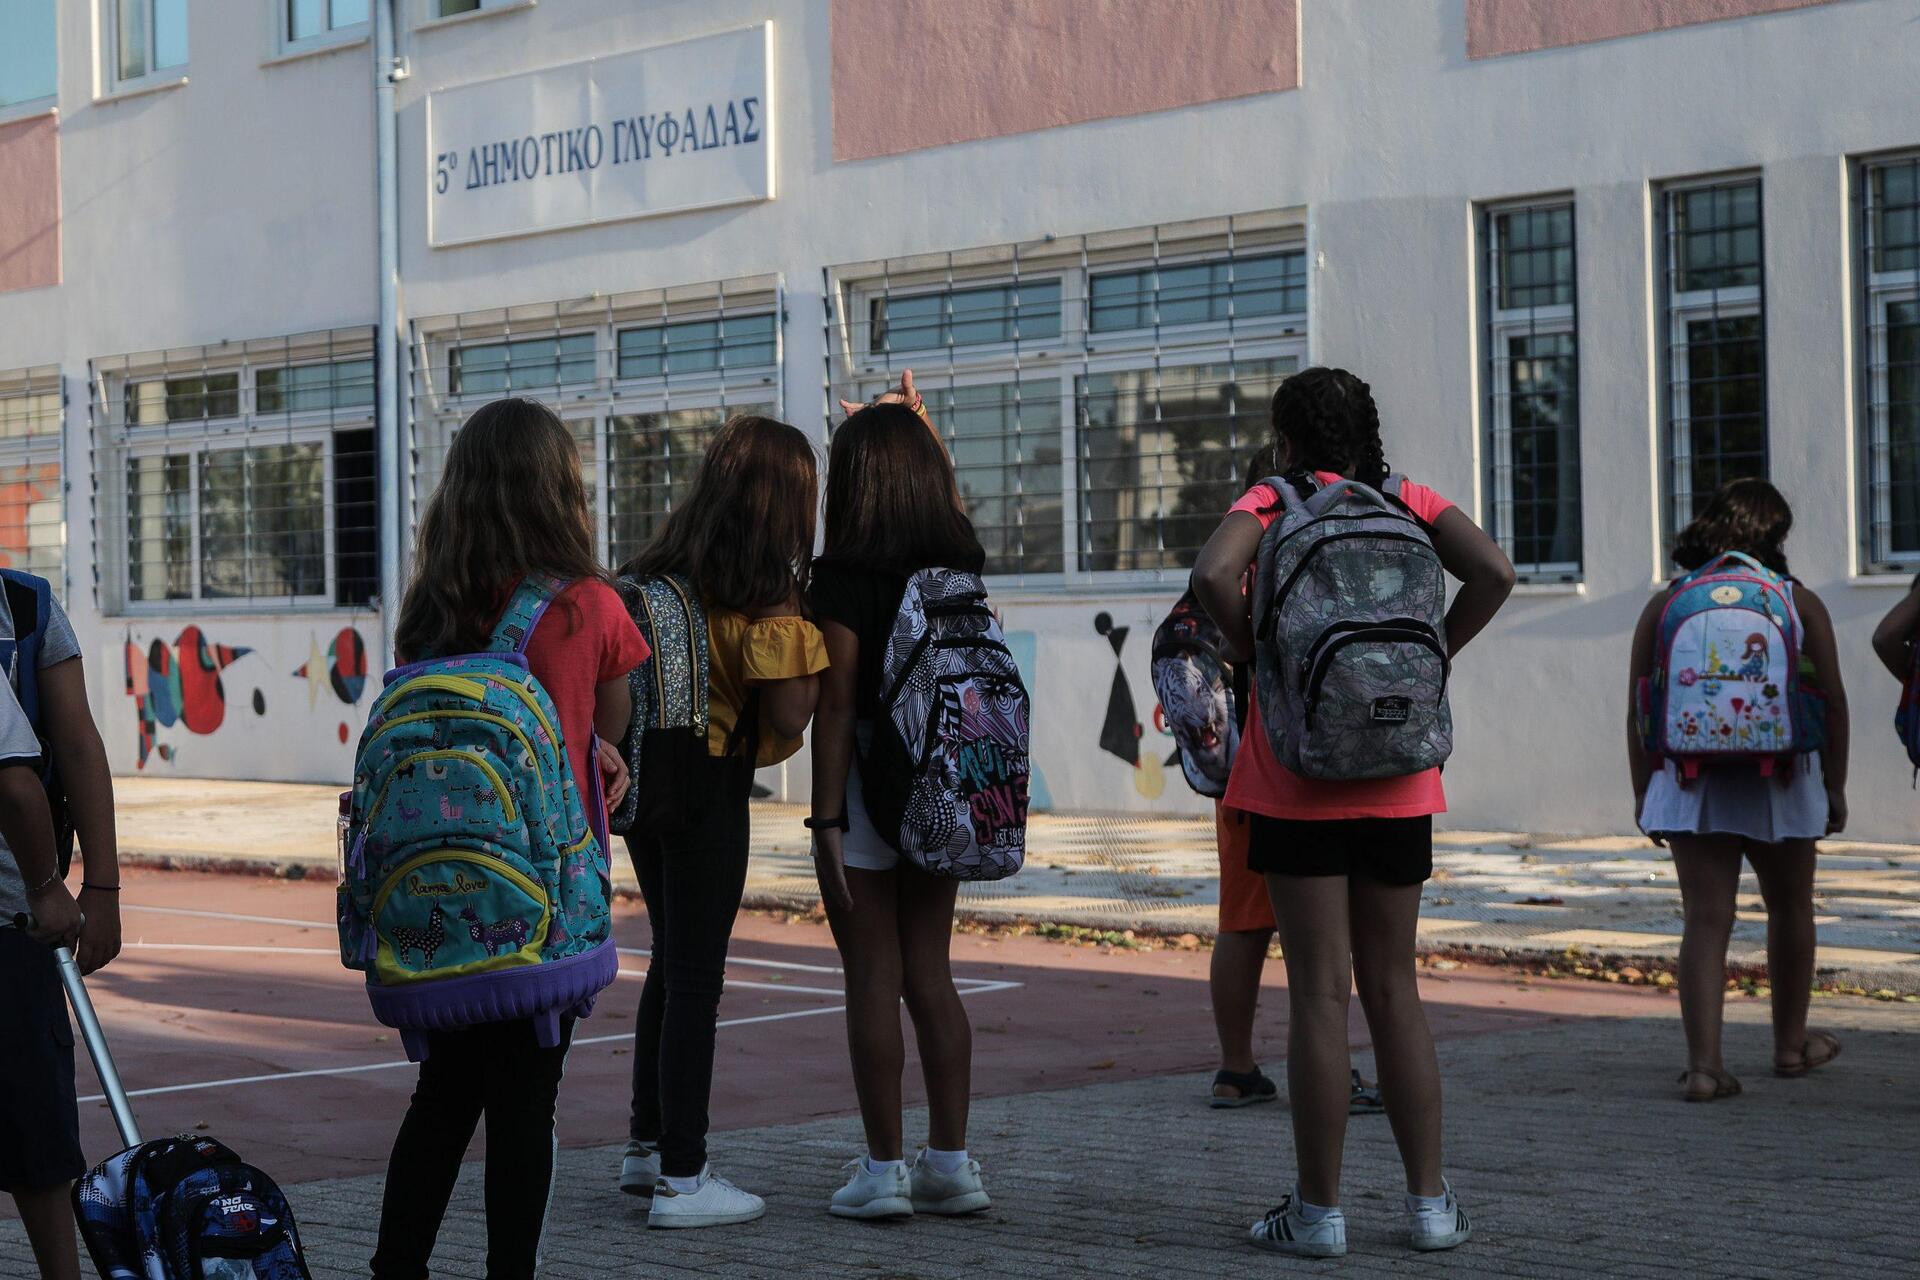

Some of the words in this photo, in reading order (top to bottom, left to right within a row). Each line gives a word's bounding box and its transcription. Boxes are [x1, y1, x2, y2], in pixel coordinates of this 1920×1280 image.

[466, 125, 603, 190] ΔΗΜΟΤΙΚΟ
[612, 97, 760, 164] ΓΛΥΦΑΔΑΣ
[221, 1196, 241, 1207] NO
